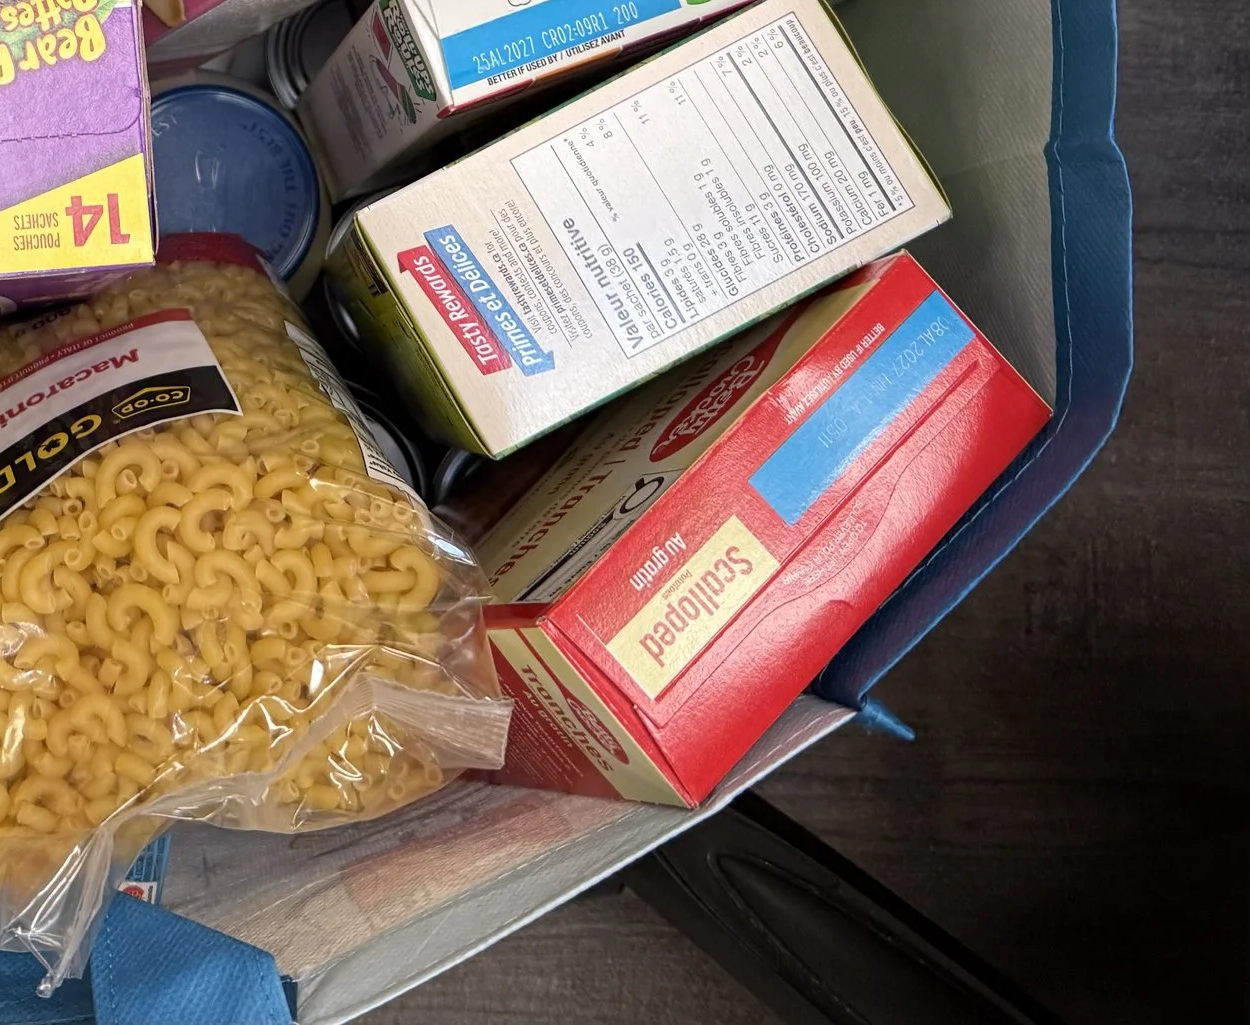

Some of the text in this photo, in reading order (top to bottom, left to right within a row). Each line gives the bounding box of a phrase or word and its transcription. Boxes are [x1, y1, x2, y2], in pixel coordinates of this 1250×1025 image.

[20, 13, 105, 69] Bear
[472, 37, 536, 73] 25AL2027
[613, 1, 639, 25] 200
[12, 211, 58, 229] SACHETS
[65, 192, 129, 246] 14
[768, 210, 806, 263] Protéines
[777, 190, 821, 254] Cholestérol
[782, 161, 838, 245] Sodium 170 mg
[12, 232, 59, 250] POUCHES
[694, 230, 741, 297] Glucides 28
[412, 253, 499, 366] Tasty Rewards
[437, 232, 543, 368] Primes et Délices
[490, 252, 532, 315] tastyrewards.ca
[517, 240, 566, 314] primesetdelices.ca
[558, 215, 646, 349] Valeur nutritive
[595, 242, 661, 339] par sachet (38 g)
[621, 245, 679, 330] Calories 150
[668, 276, 699, 319] Lipides
[626, 531, 689, 592] Au gratin
[633, 542, 757, 667] Scalloped
[519, 663, 616, 776] Tranches
